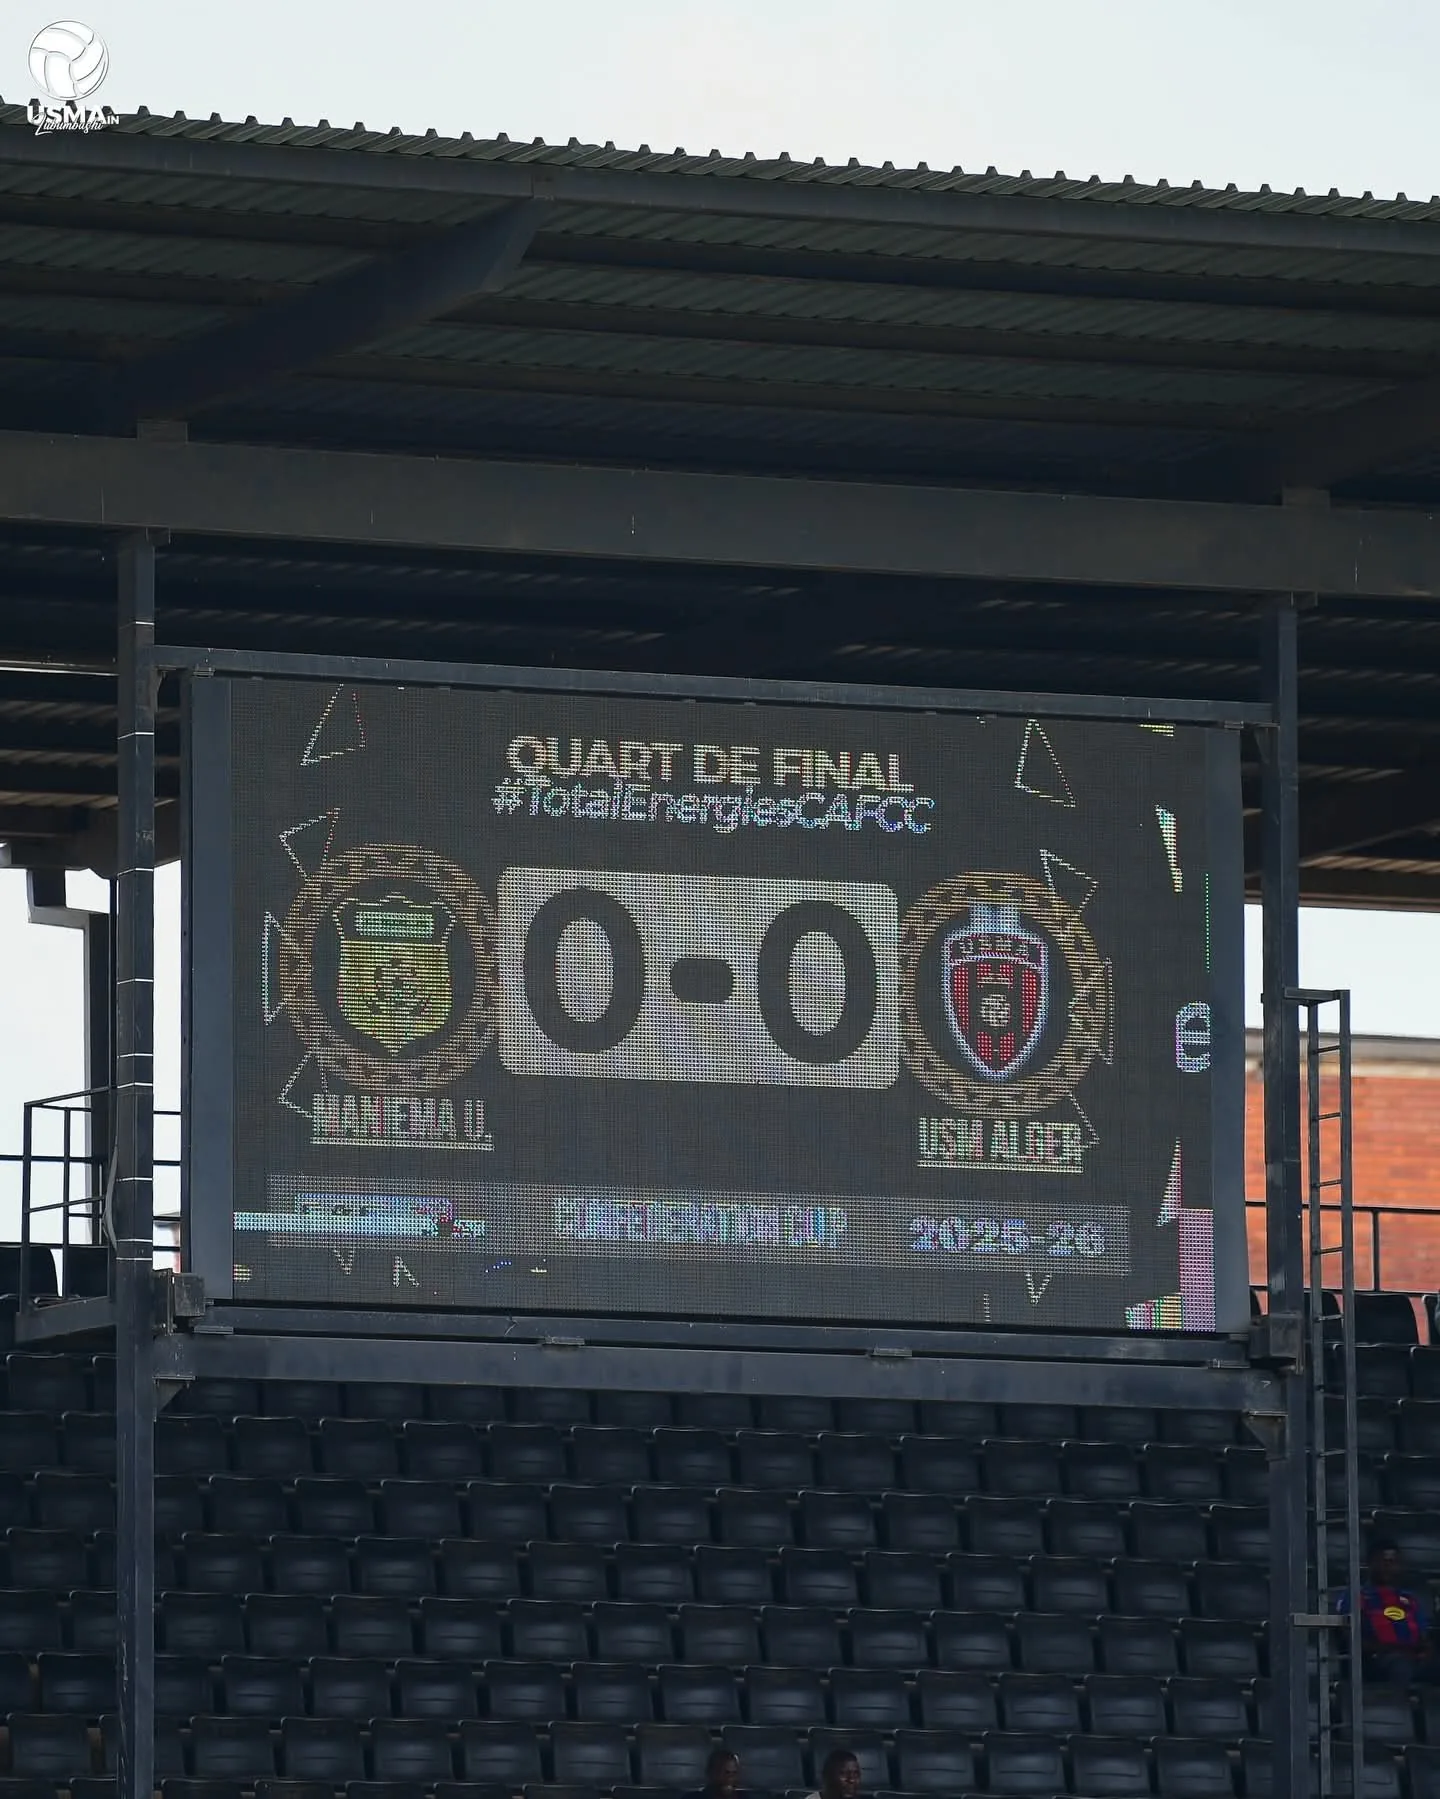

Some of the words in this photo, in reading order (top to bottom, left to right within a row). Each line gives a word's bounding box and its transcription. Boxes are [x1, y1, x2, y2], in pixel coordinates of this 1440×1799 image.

[506, 735, 683, 783] QUART
[693, 744, 761, 786] DE
[773, 747, 914, 793] FINAL
[491, 776, 936, 834] #TotalEnergiesCAFCC
[918, 1117, 984, 1160] USM
[991, 1119, 1083, 1164] ALGER
[783, 1205, 848, 1249] CUP
[909, 1215, 1106, 1258] 2025-26
